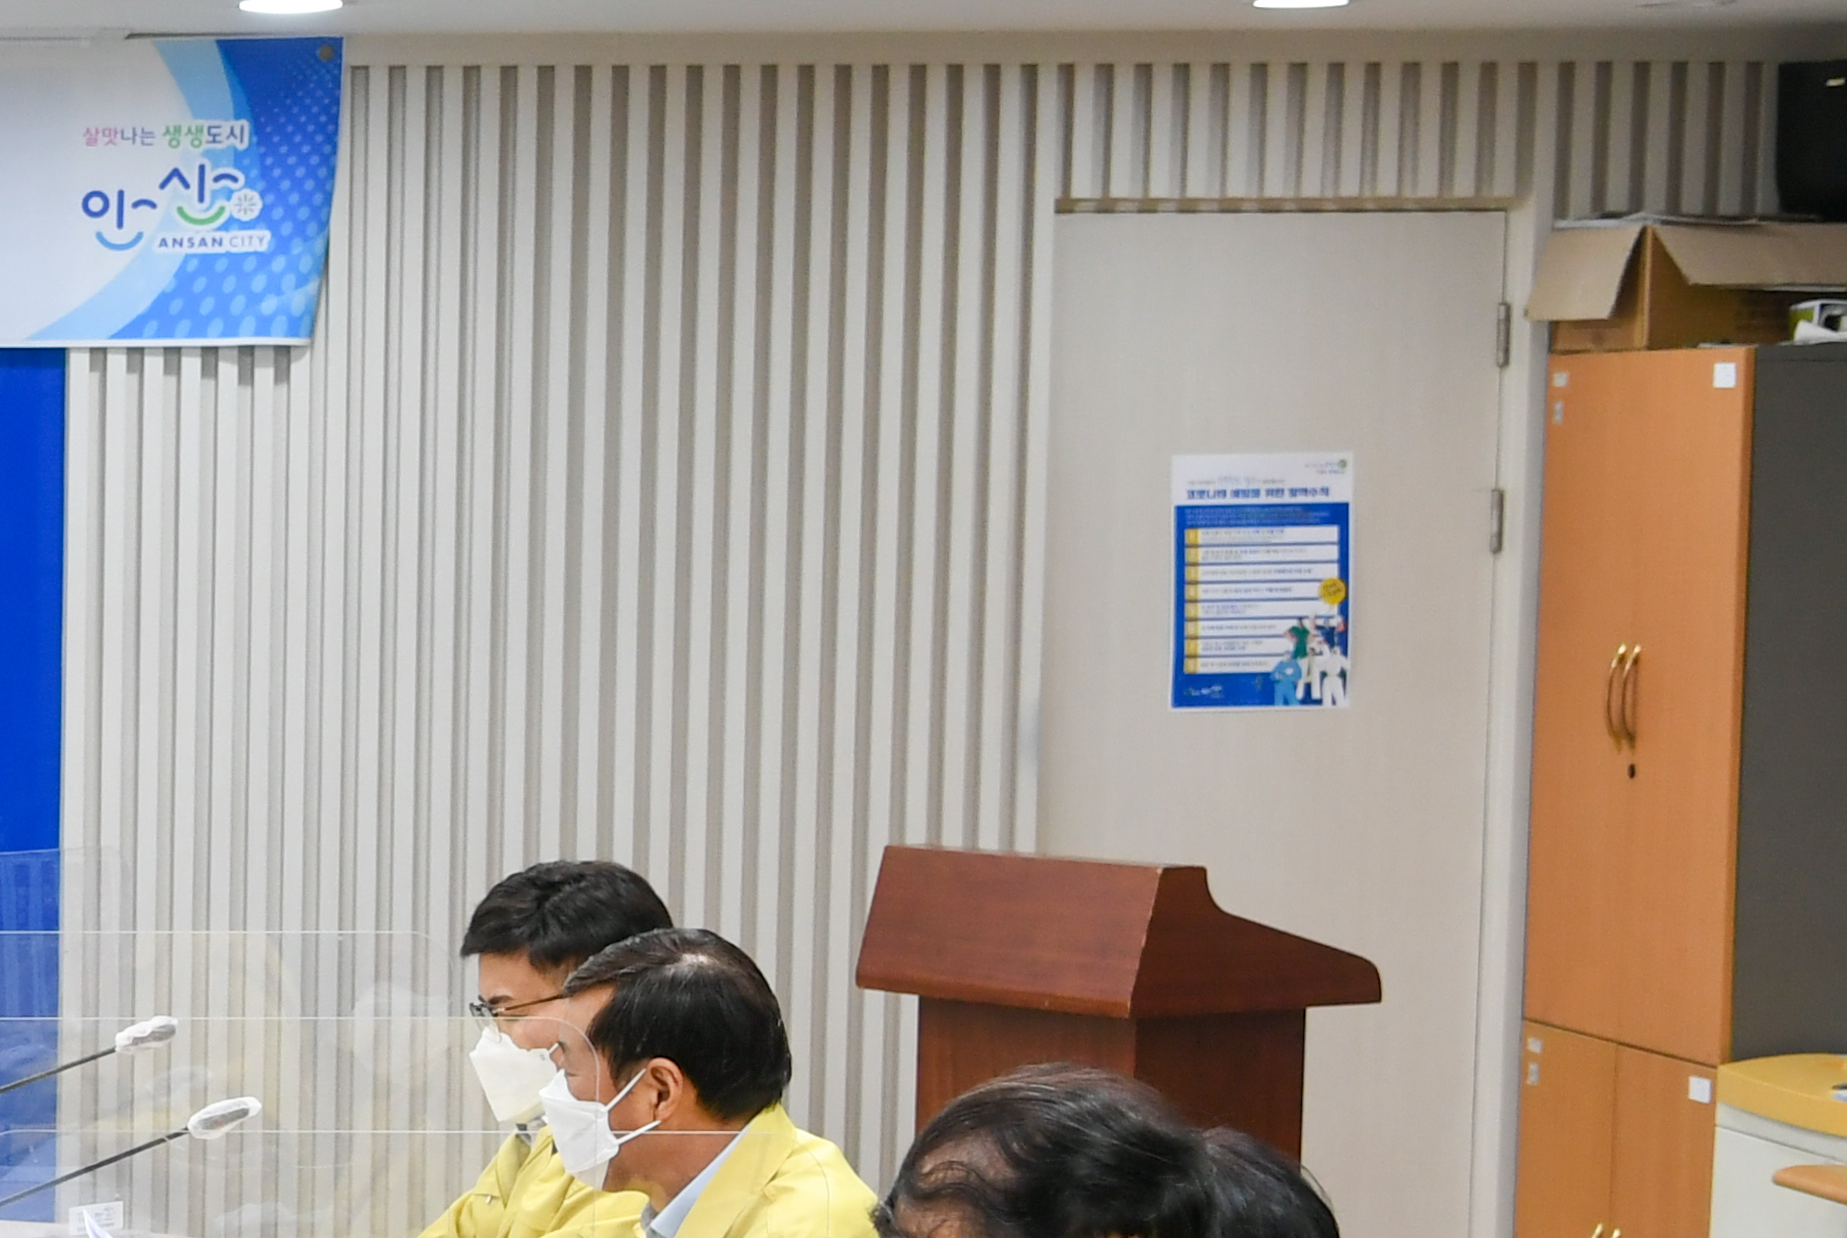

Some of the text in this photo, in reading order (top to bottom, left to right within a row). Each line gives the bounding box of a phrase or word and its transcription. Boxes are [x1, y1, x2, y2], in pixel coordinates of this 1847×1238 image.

[82, 124, 247, 149] 살맛나는 생생도시
[157, 234, 269, 249] ANSAN CITY
